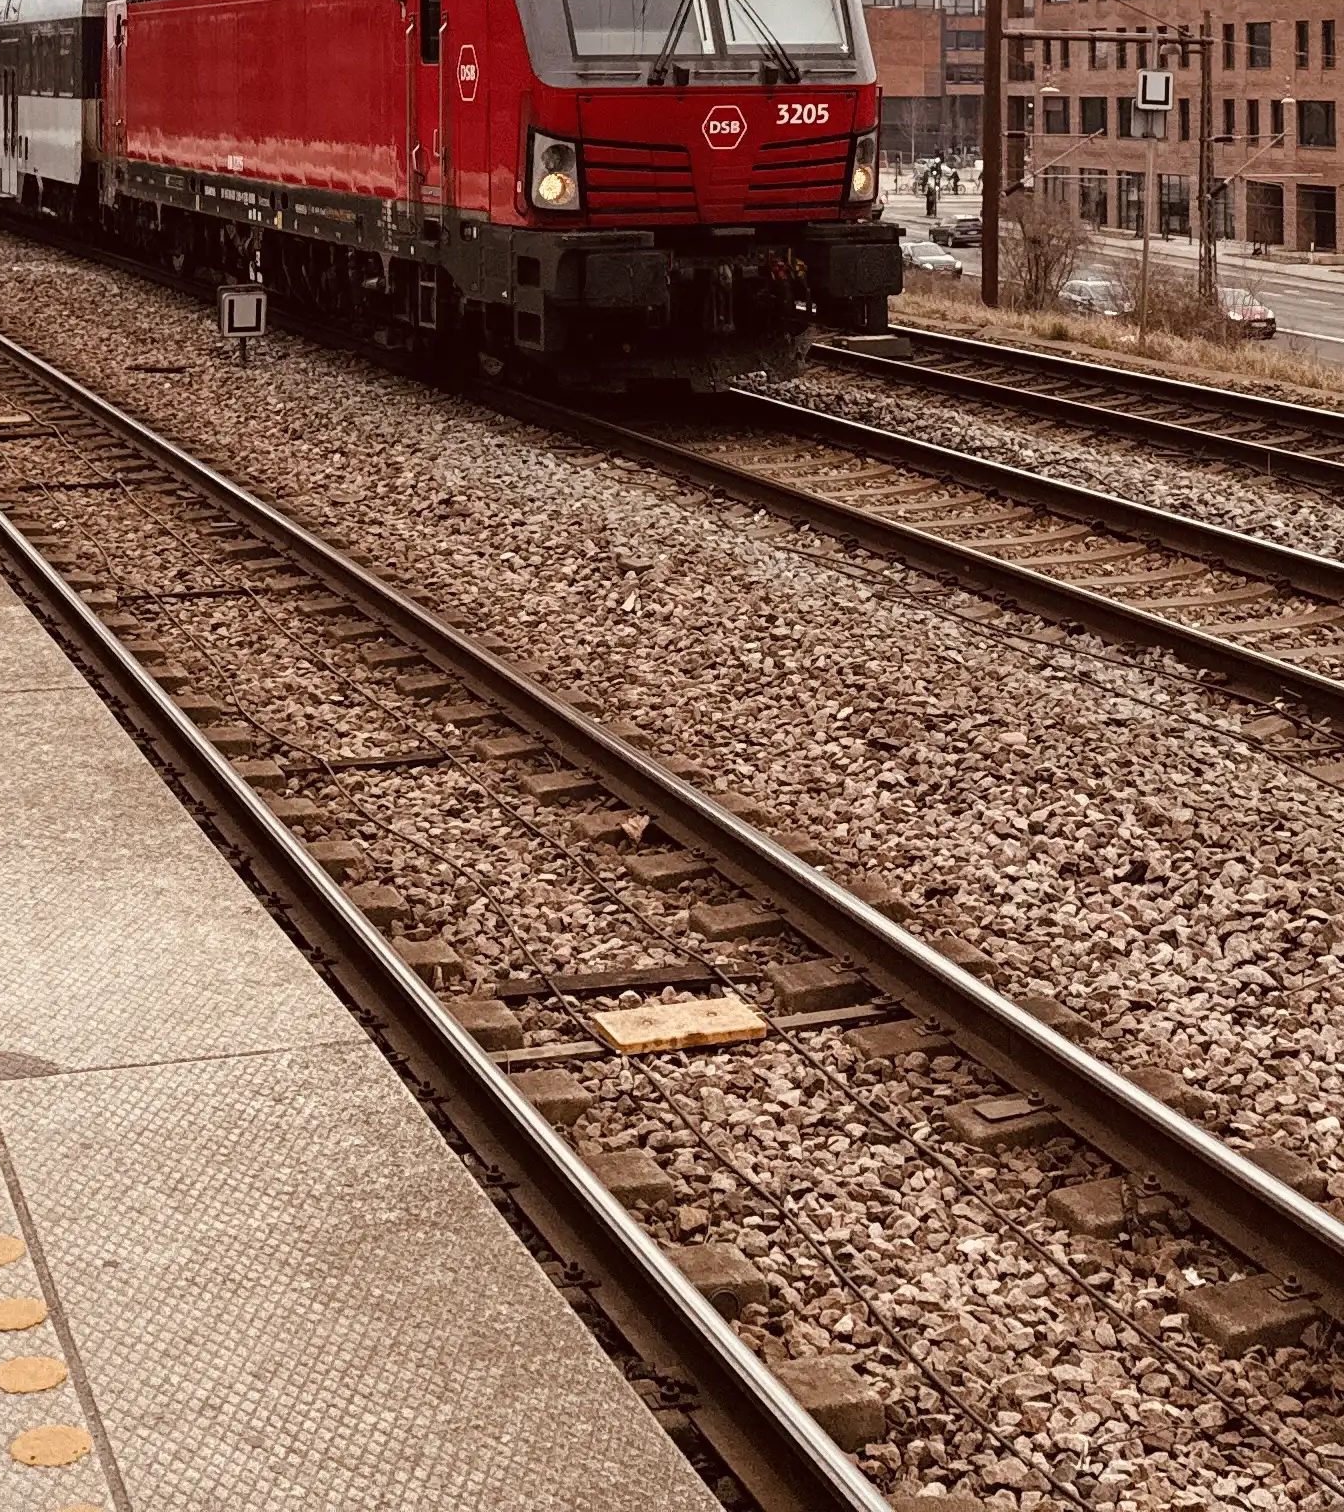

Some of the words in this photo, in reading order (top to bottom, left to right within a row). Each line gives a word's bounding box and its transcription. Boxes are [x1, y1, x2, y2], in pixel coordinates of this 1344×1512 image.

[460, 64, 476, 81] DSB
[776, 103, 829, 125] 3205
[709, 120, 741, 134] DSB
